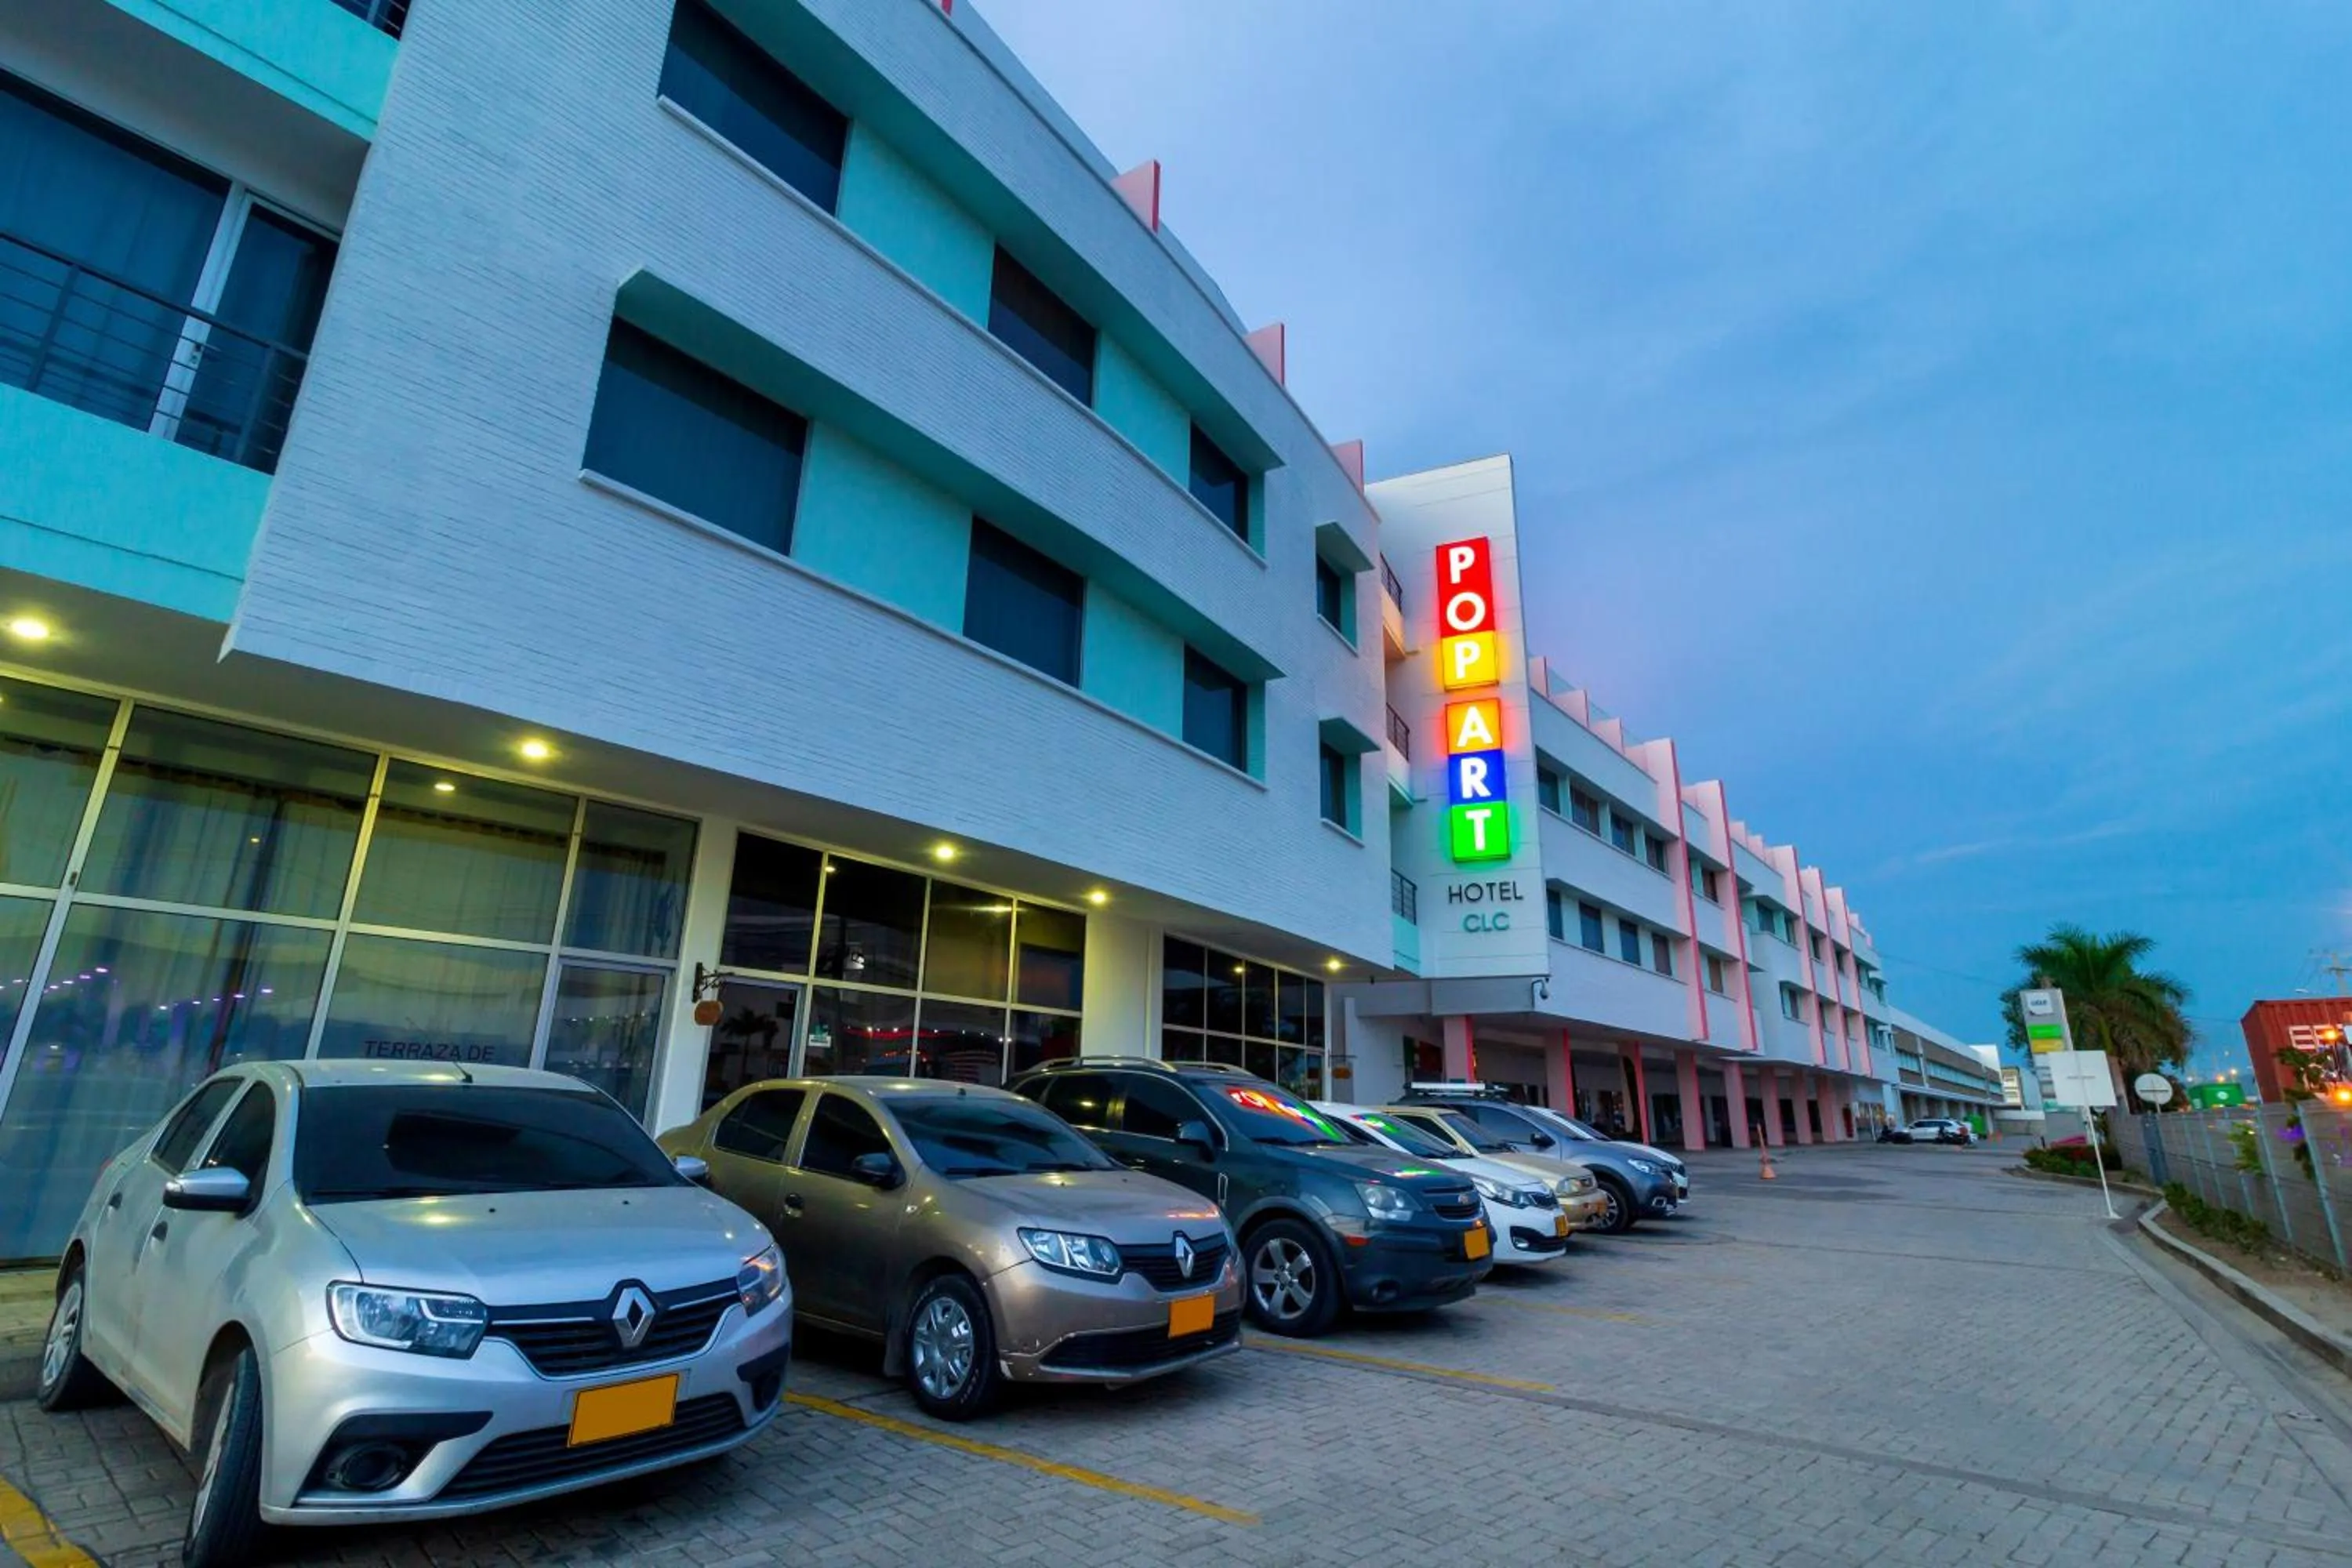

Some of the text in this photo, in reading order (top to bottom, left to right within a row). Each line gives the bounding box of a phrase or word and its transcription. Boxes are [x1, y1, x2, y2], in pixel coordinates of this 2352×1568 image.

[1446, 546, 1485, 679] POP
[1457, 706, 1492, 851] ART
[1448, 880, 1524, 904] HOTEL
[1463, 912, 1510, 933] CLC
[365, 1040, 495, 1061] TERRAZA DE
